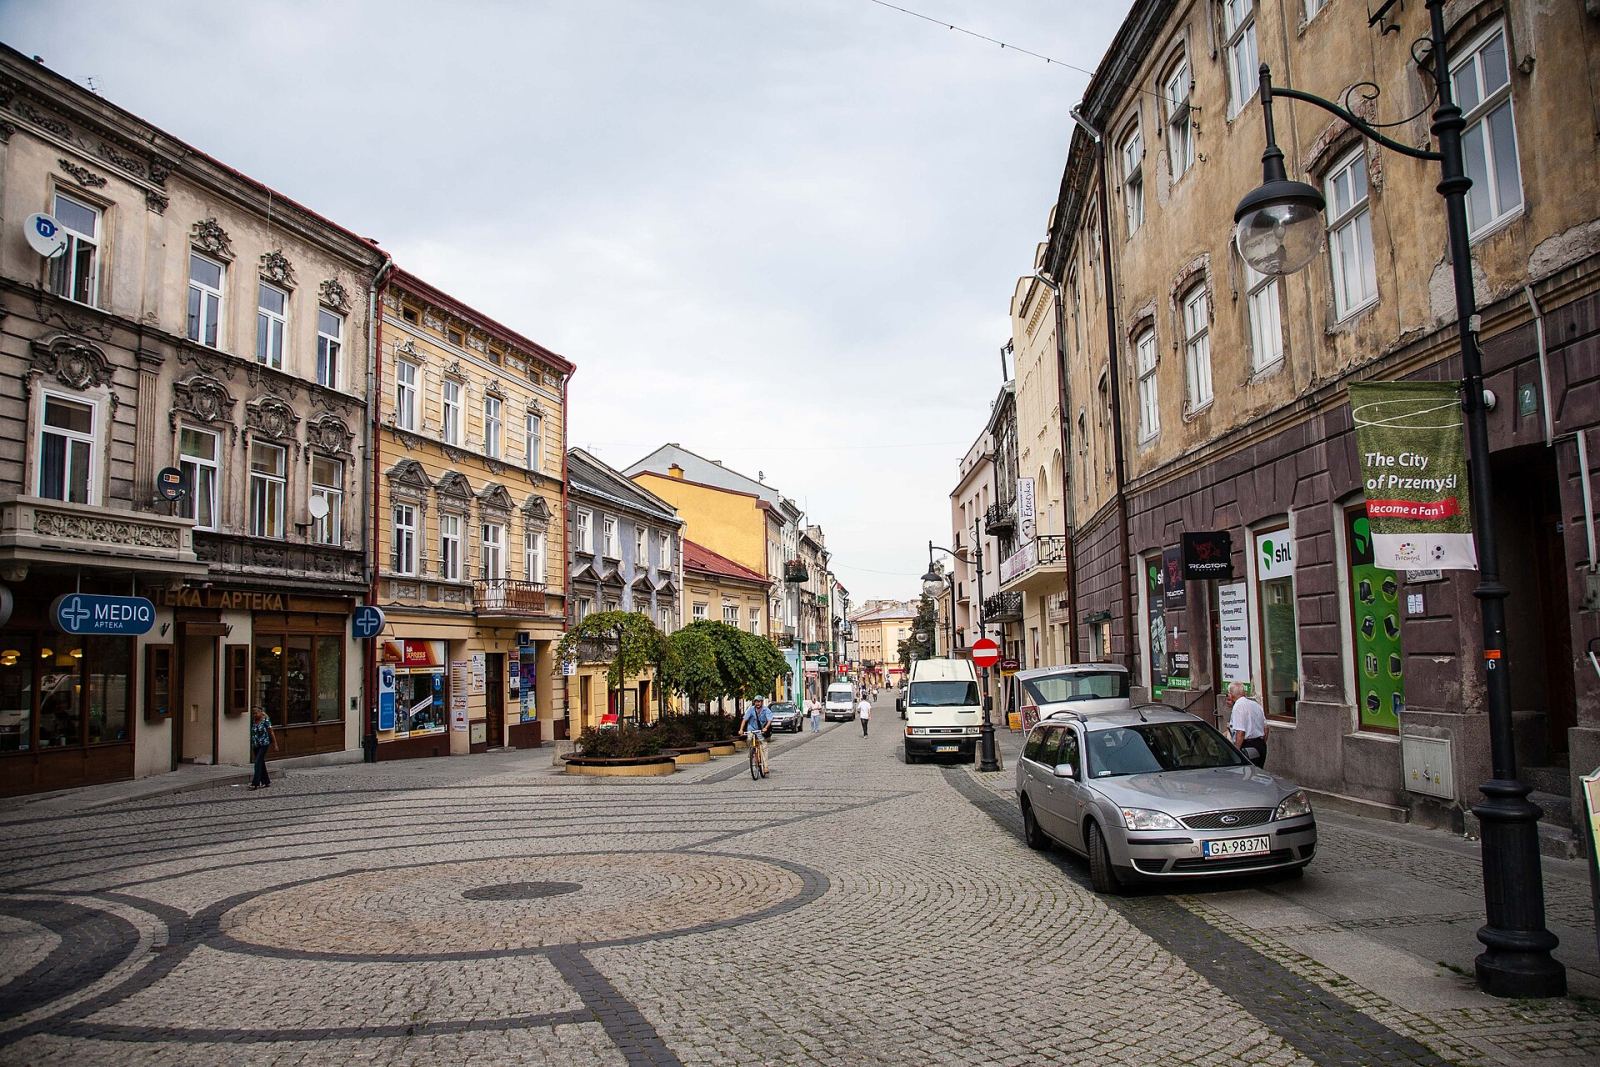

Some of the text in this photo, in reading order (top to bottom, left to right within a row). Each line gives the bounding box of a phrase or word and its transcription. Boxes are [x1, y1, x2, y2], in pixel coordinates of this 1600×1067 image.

[1524, 390, 1530, 402] 2
[1365, 452, 1428, 470] The City
[1367, 474, 1457, 492] of Przemyśl
[1024, 481, 1033, 517] Estetyka
[1419, 506, 1438, 516] Fan
[1276, 542, 1292, 562] shl
[220, 591, 284, 611] APTEKA
[94, 604, 150, 622] MEDIQ
[520, 634, 526, 644] L
[1488, 659, 1496, 670] 6
[1211, 842, 1228, 854] GA
[1232, 838, 1268, 852] 9837N
